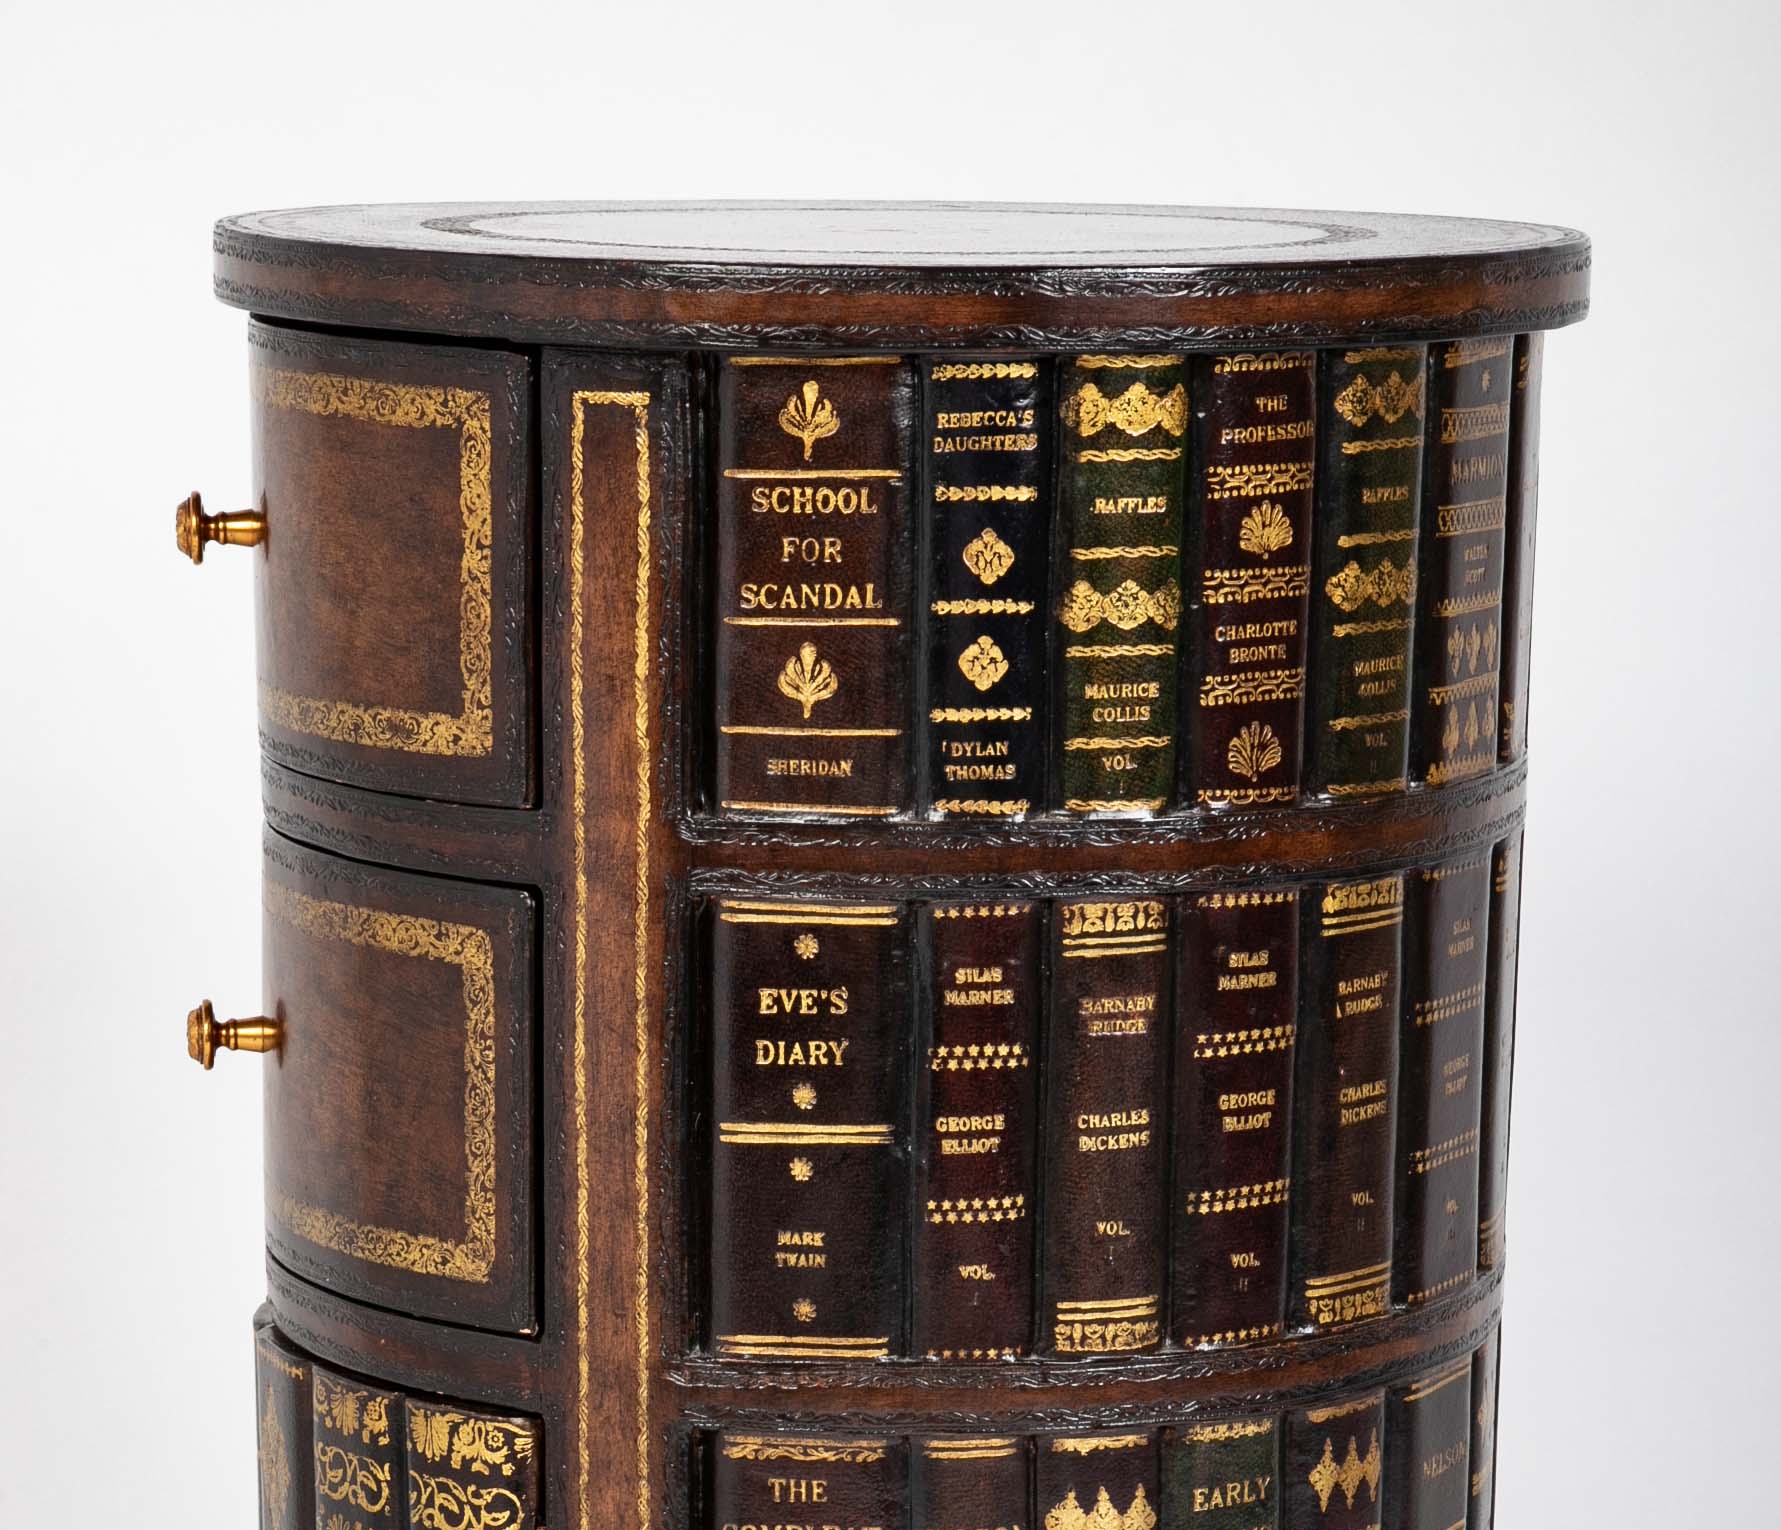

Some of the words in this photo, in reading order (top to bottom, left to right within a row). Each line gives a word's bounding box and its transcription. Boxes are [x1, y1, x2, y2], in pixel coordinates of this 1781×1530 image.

[1255, 394, 1288, 413] THE
[937, 410, 1034, 429] REBECCA'S
[1221, 420, 1314, 445] PROFESSOR
[933, 433, 1038, 454] DAUGHTERS
[752, 487, 878, 514] SCHOOL
[1361, 486, 1409, 504] RAFFLES
[1095, 496, 1167, 514] RAFFLES
[781, 538, 842, 563] FOR
[740, 583, 882, 609] SCANDAL
[1215, 621, 1298, 641] CHARLOTTE
[1229, 645, 1287, 664] BRONTE
[1085, 682, 1159, 700] MAURICE
[1092, 706, 1151, 723] COLLIS
[950, 742, 1009, 757] DYLAN
[766, 759, 853, 778] SHERIDAN
[944, 763, 1016, 781] THOMAS
[1229, 951, 1269, 968] SILAS
[954, 967, 1003, 984] SILAS
[1218, 971, 1277, 990] MARNER
[1338, 970, 1388, 996] BARNABY
[759, 987, 849, 1016] EVE'S
[943, 988, 1015, 1005] MARNER
[755, 1038, 850, 1066] DIARY
[1219, 1089, 1275, 1110] GEORGE
[1339, 1080, 1387, 1103] CHARLES
[936, 1114, 1005, 1132] GEORGE
[1078, 1109, 1150, 1130] CHARLES
[1340, 1101, 1387, 1126] DICKENS
[941, 1137, 1000, 1154] ELLIOT
[1079, 1131, 1150, 1152] DICKENS
[777, 1231, 825, 1247] MARK
[775, 1253, 827, 1269] TWAIN
[768, 1478, 828, 1503] THE
[1193, 1476, 1270, 1512] EARLY
